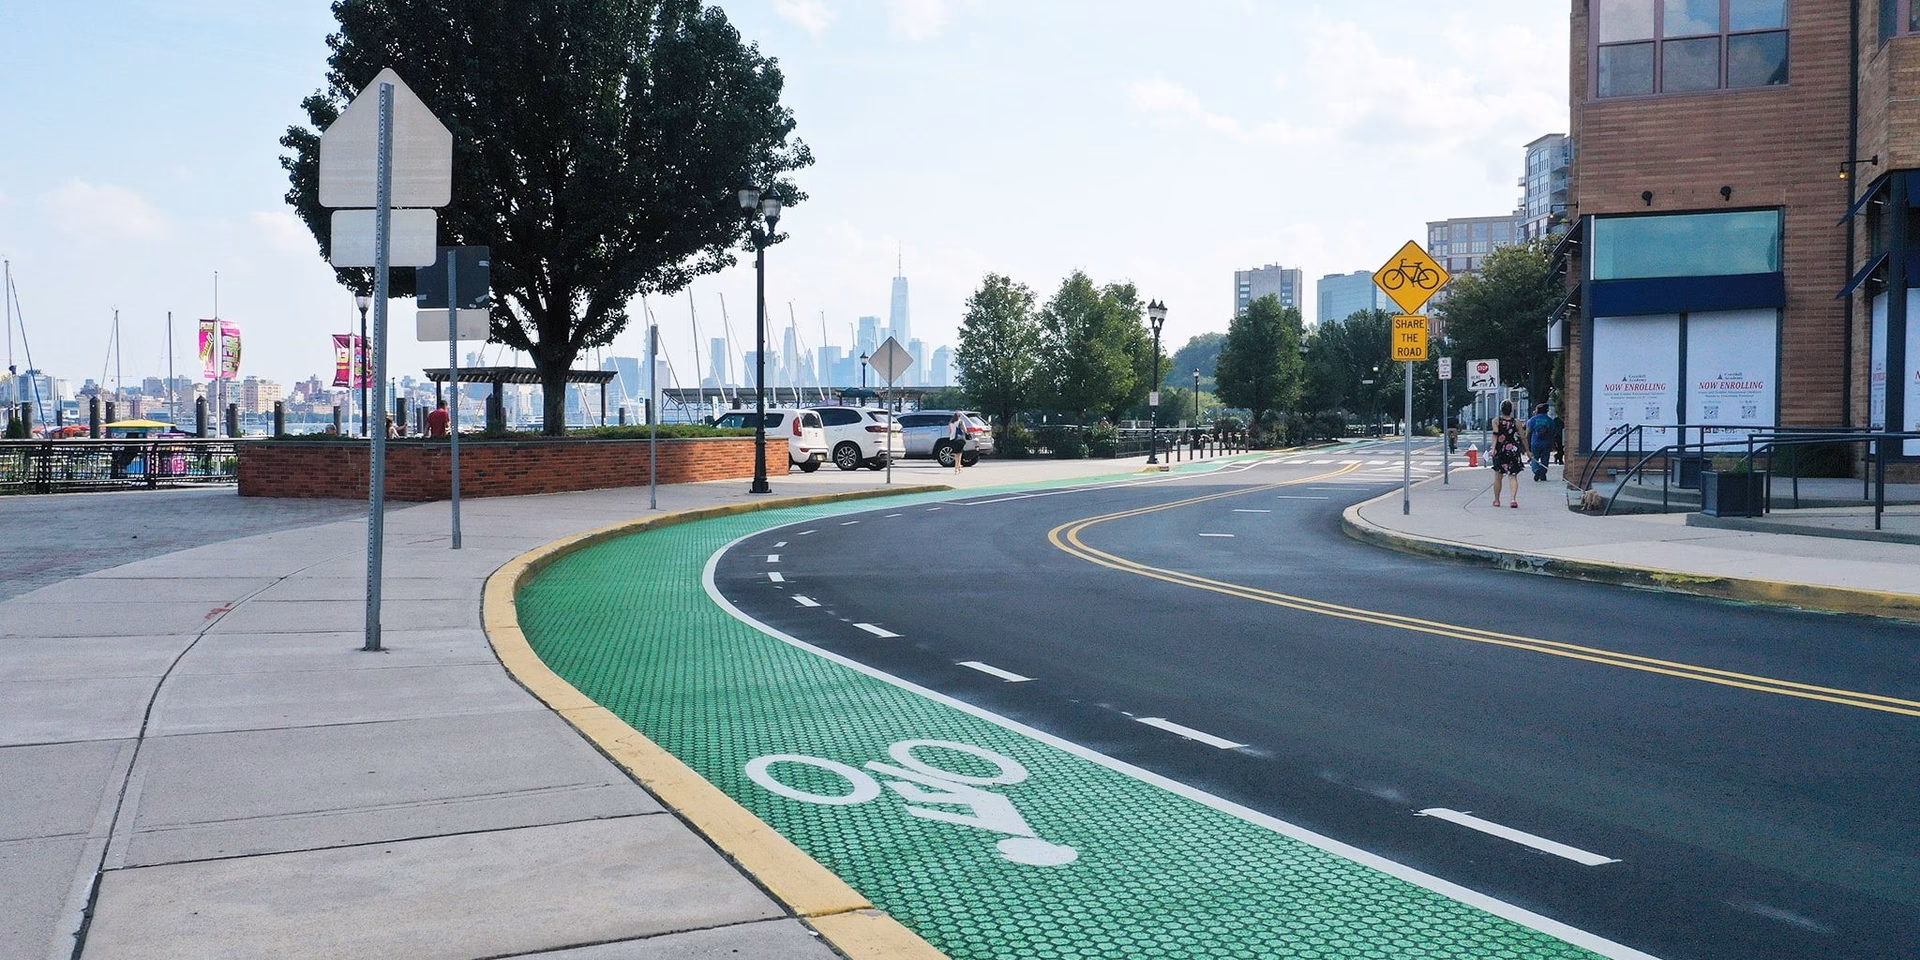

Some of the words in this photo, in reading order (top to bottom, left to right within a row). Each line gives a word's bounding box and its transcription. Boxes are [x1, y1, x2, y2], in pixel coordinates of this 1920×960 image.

[1395, 319, 1425, 329] SHARE
[1401, 333, 1418, 343] THE
[1397, 347, 1422, 357] ROAD
[1604, 383, 1623, 392] NOW
[1624, 383, 1667, 391] ENROLLING
[1698, 382, 1718, 390] NOW
[1719, 381, 1763, 390] ENROLLING
